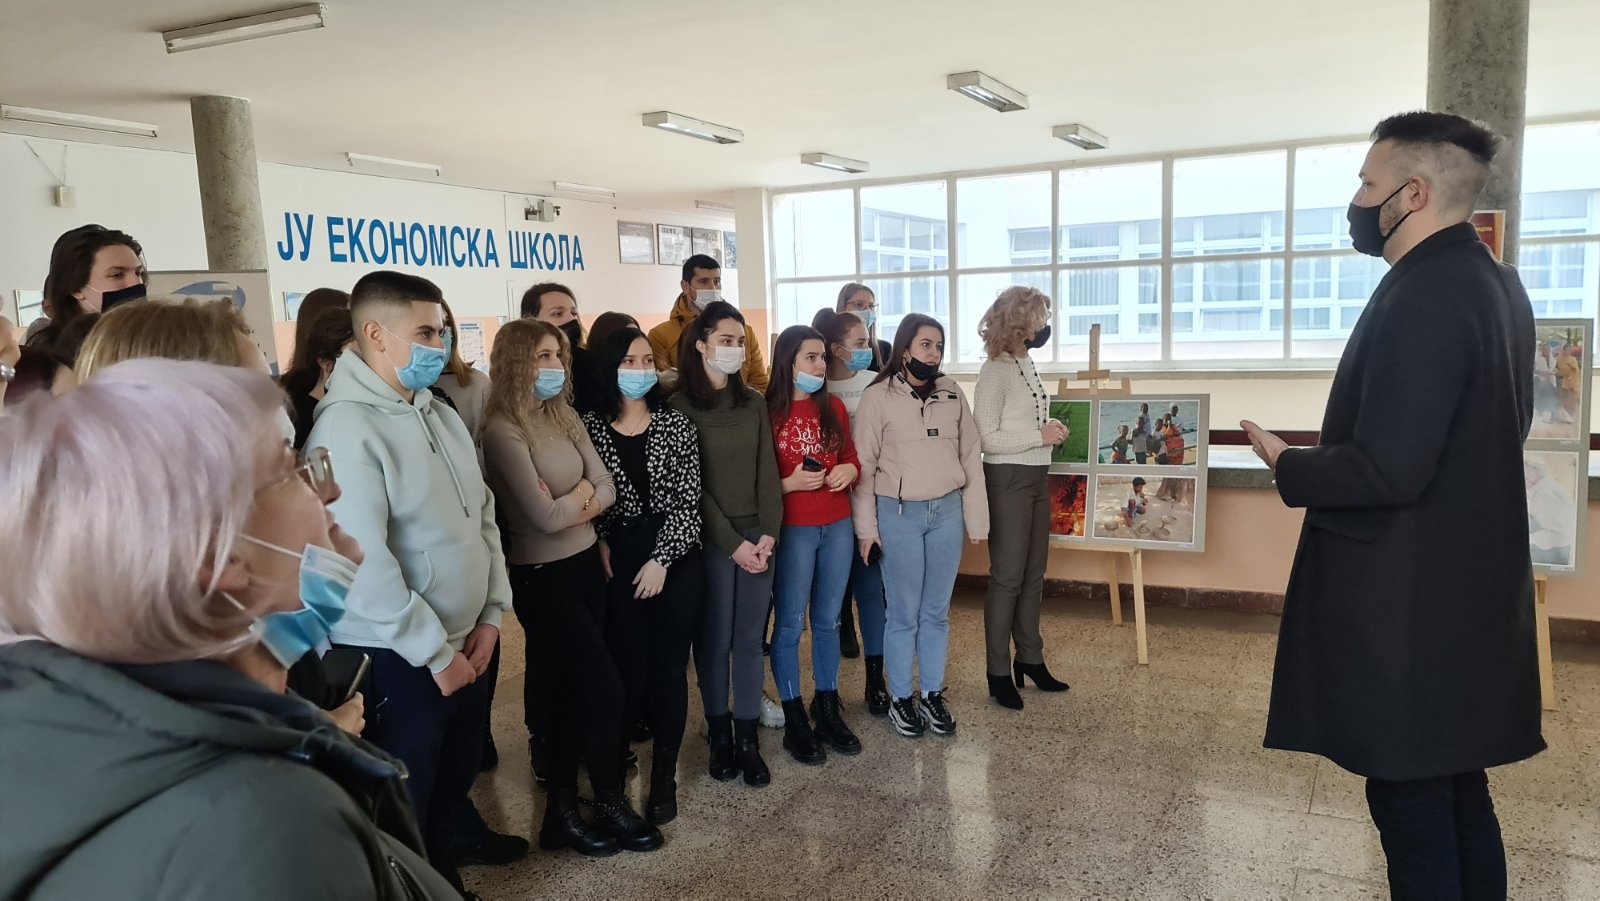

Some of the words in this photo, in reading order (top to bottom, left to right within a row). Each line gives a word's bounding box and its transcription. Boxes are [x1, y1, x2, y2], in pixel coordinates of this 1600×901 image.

[277, 212, 314, 262] ЈУ
[326, 216, 500, 268] ЕКОНОМСКА
[508, 230, 585, 271] ШКОЛА
[791, 424, 816, 444] Let
